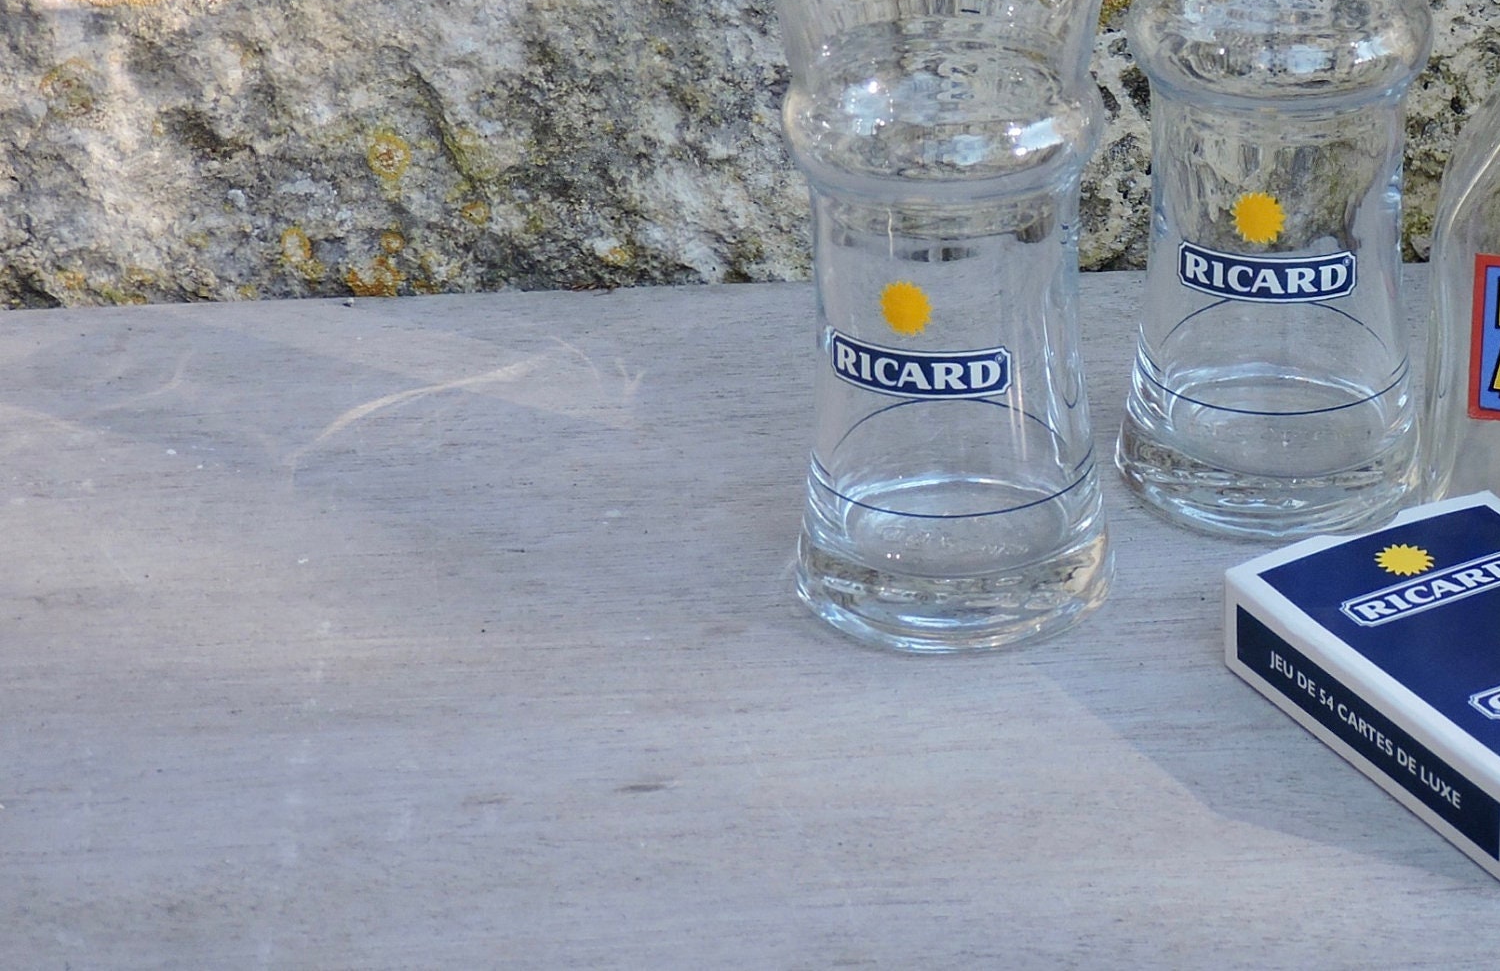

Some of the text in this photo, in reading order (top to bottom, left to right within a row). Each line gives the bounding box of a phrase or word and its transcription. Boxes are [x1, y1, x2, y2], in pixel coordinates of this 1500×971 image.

[1185, 251, 1348, 294] RICARD
[836, 341, 1001, 390] RICARD
[1270, 651, 1461, 809] JEU DE 54 CARTES DE LUXE
